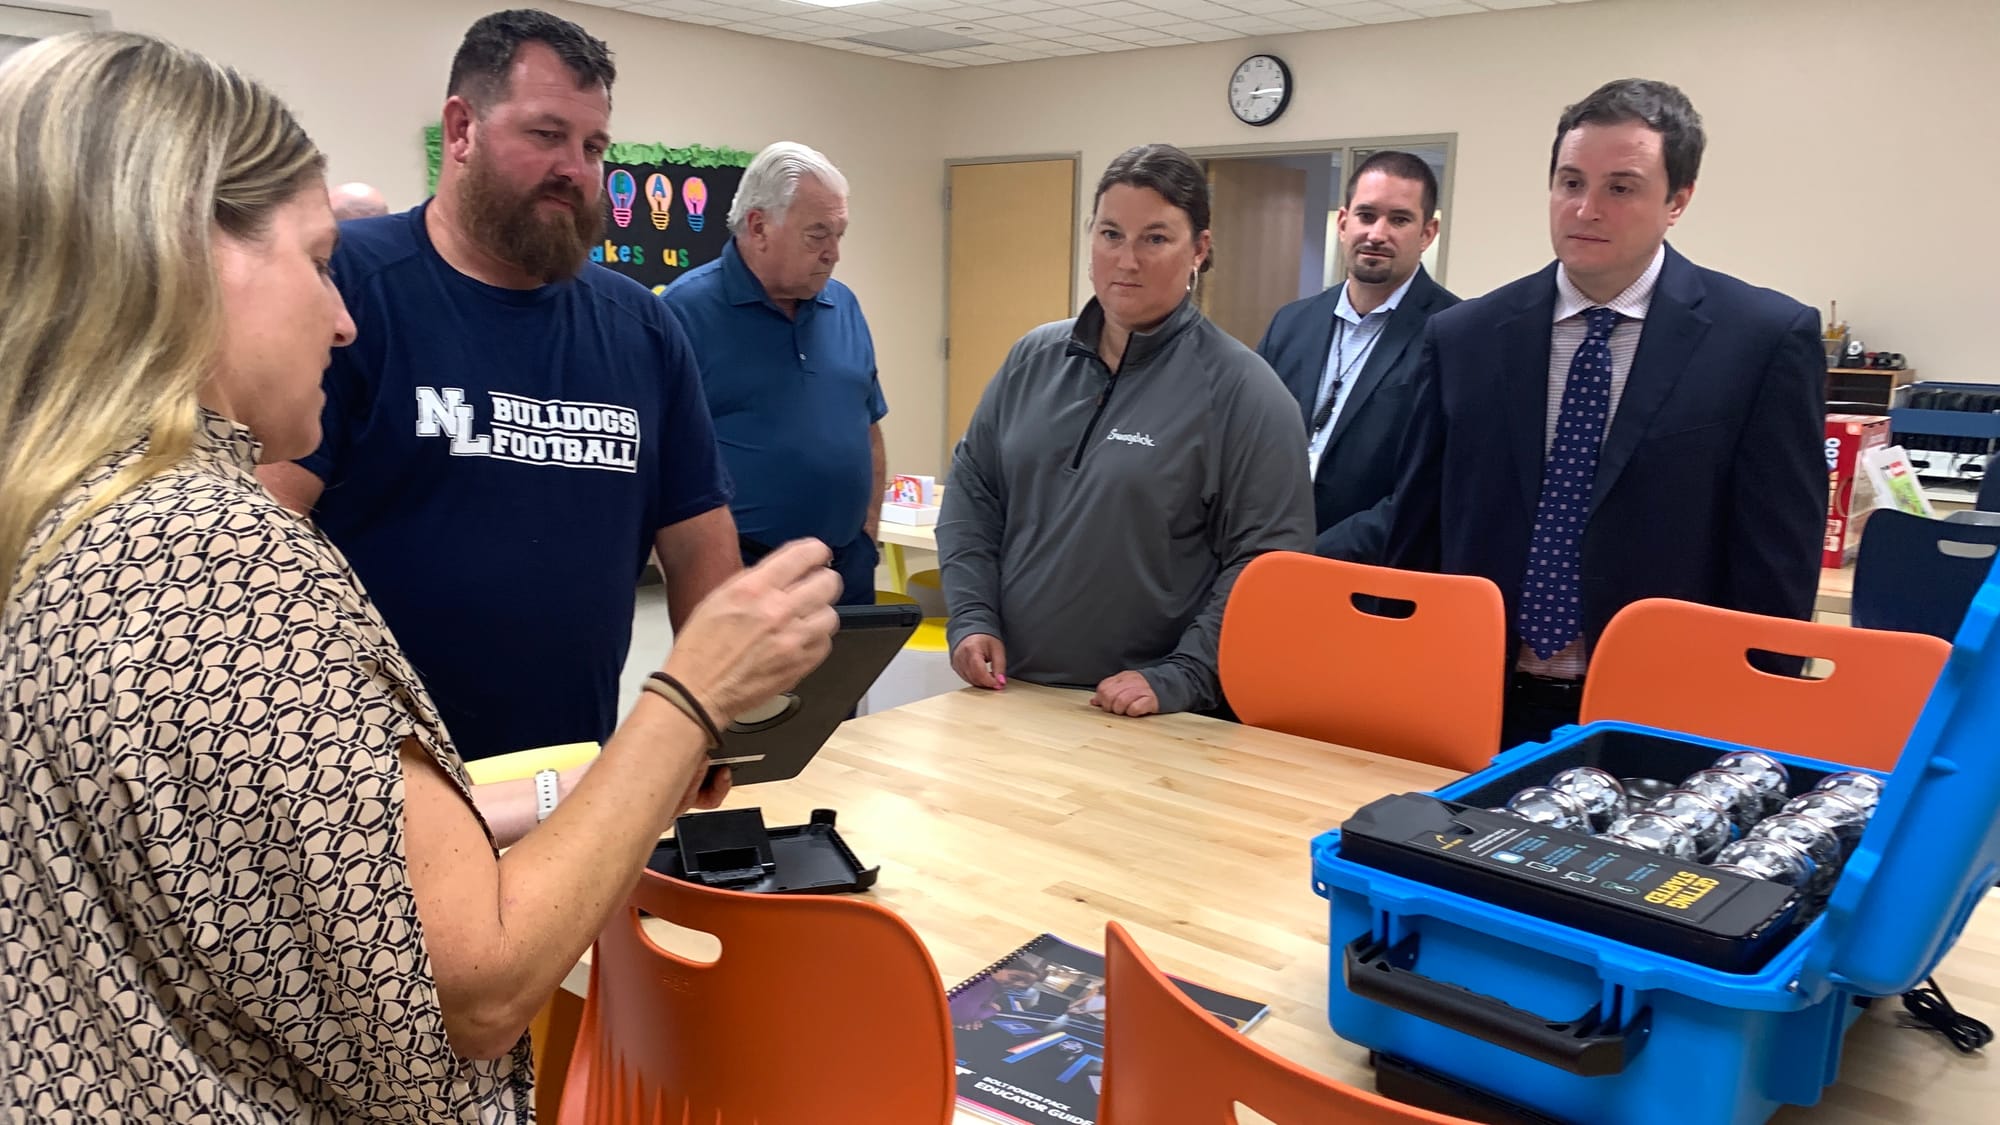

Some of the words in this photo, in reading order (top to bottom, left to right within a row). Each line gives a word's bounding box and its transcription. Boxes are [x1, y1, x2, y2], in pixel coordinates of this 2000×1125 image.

[588, 239, 645, 265] akes
[662, 248, 690, 268] us
[416, 386, 491, 457] NL
[491, 396, 637, 436] BULLDOGS
[492, 427, 637, 467] FOOTBALL
[1643, 871, 1700, 904] STARTED
[1665, 877, 1720, 910] GETTING
[973, 1081, 1048, 1113] EDUCATOR
[1047, 1107, 1096, 1125] GUIDE
[982, 1076, 1011, 1089] BOLT
[1006, 1084, 1044, 1102] POWER
[1042, 1097, 1072, 1111] PACK
